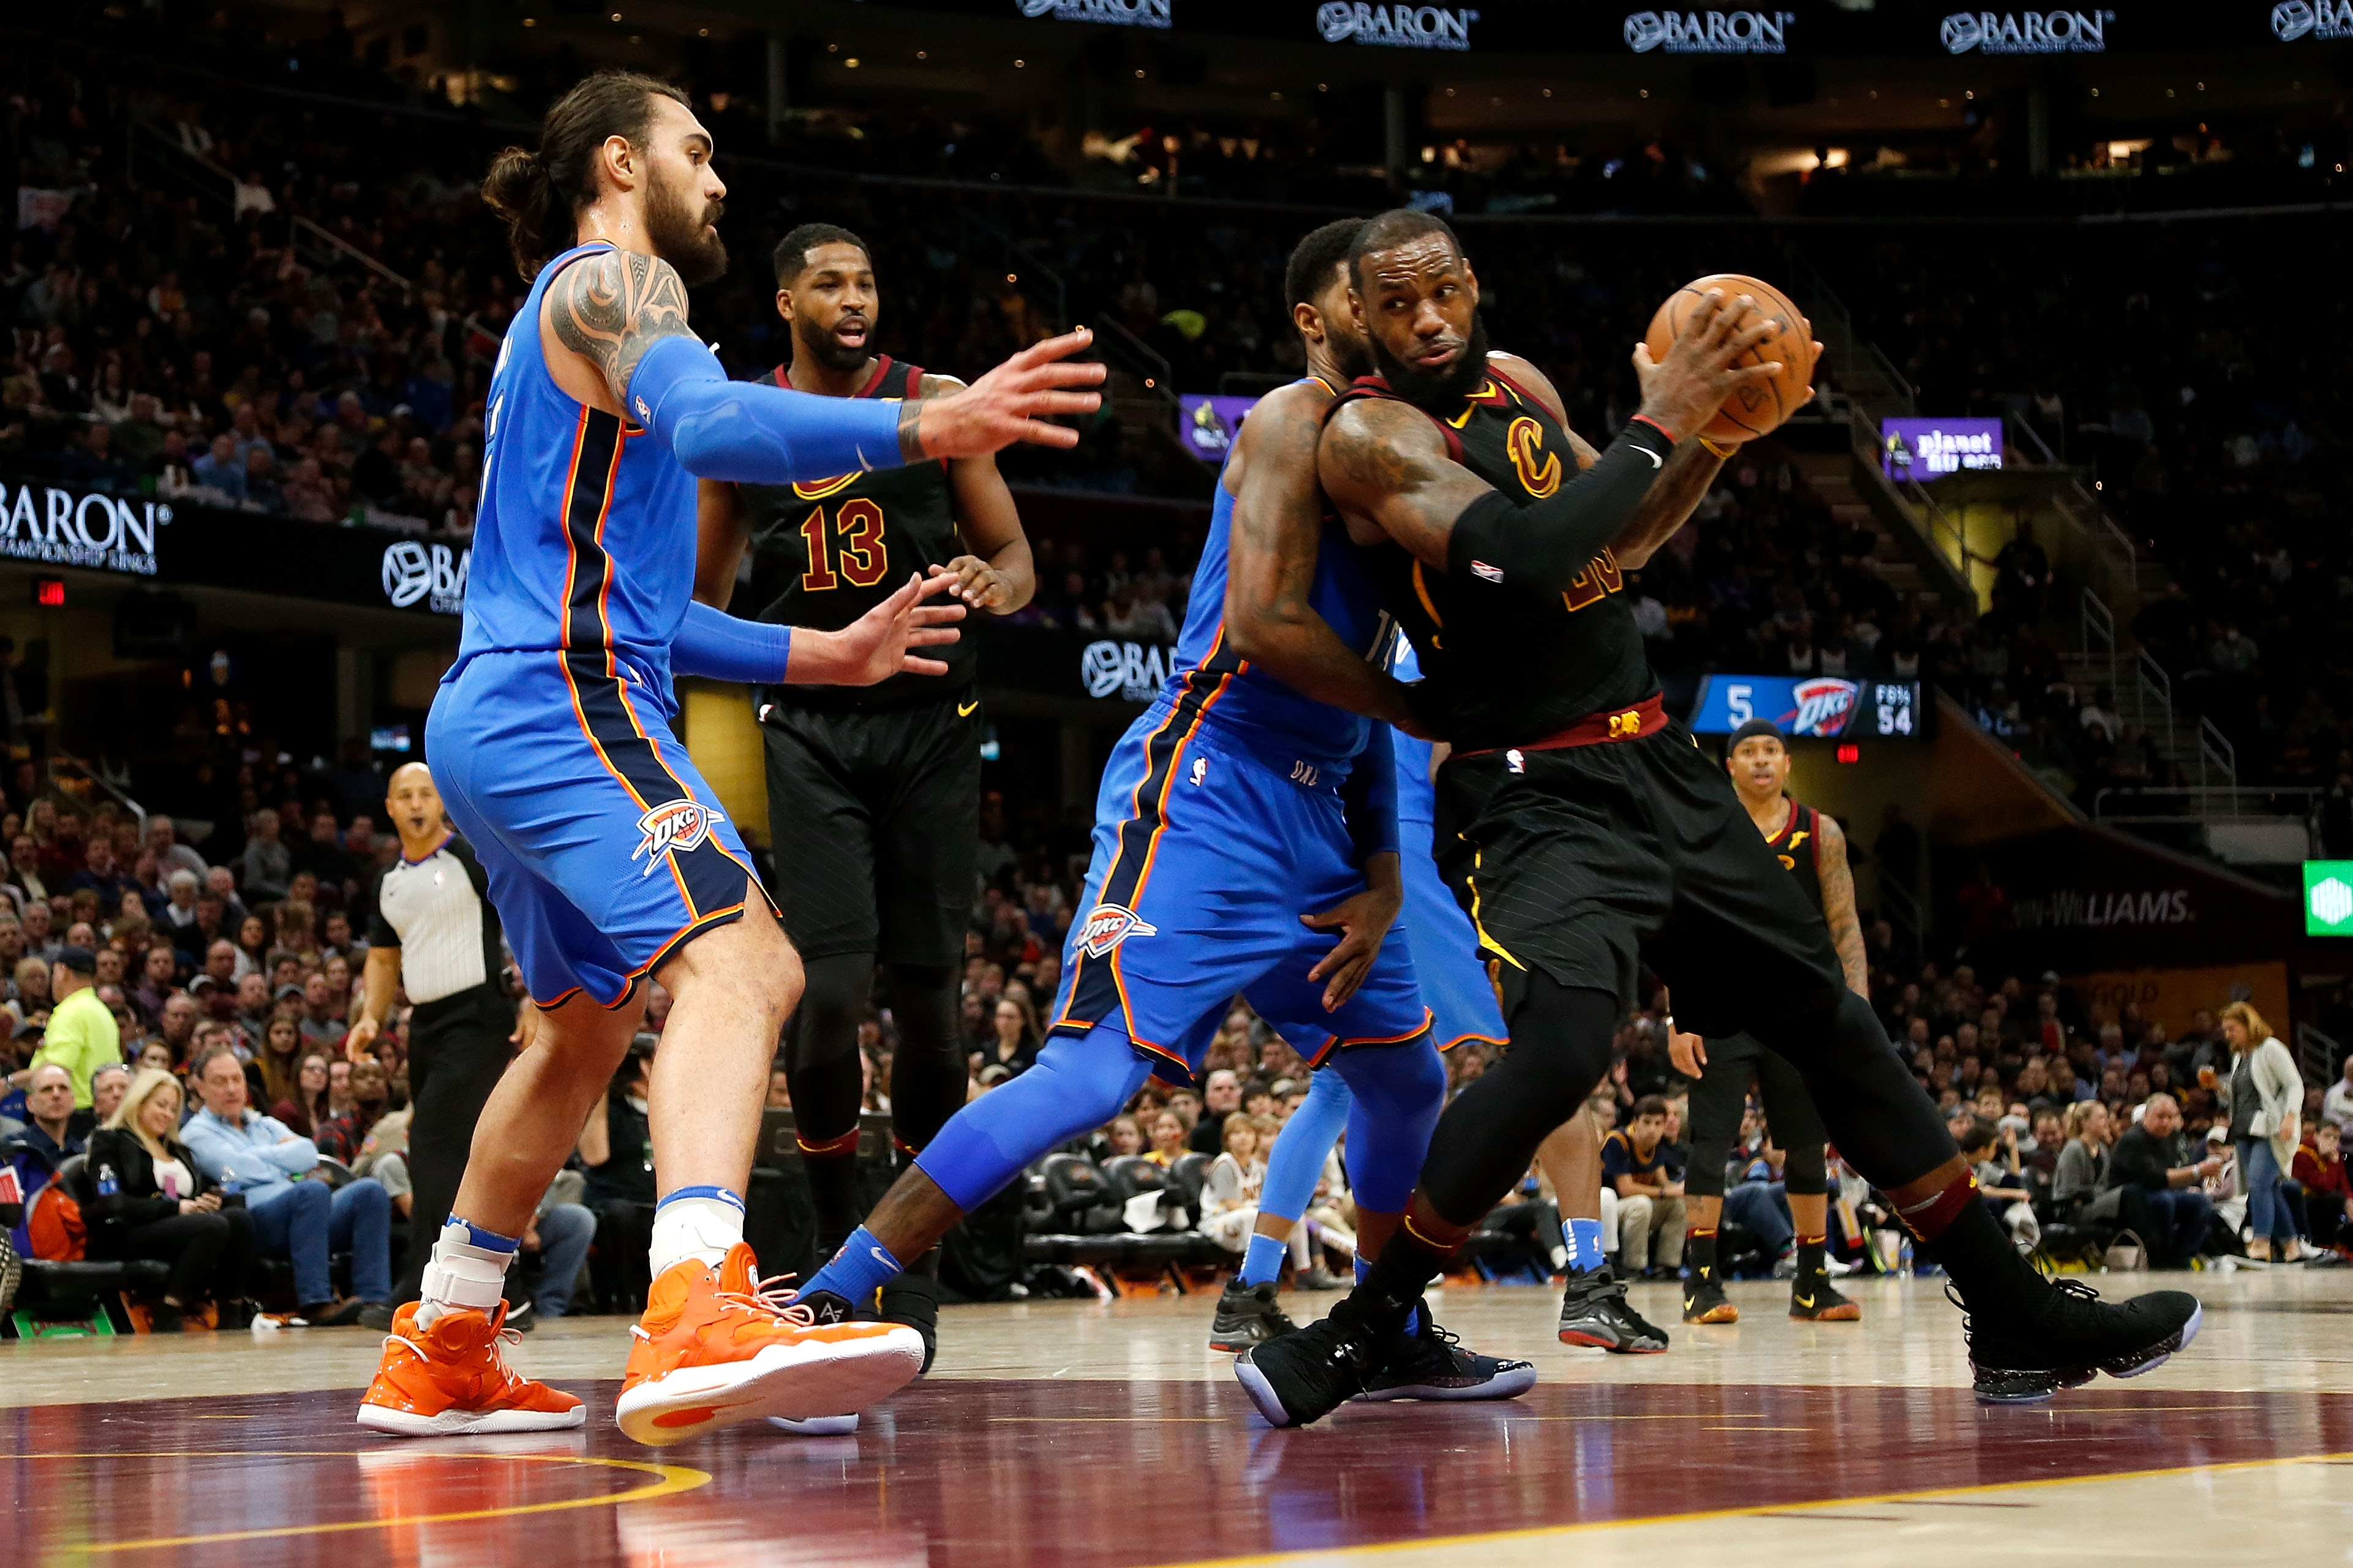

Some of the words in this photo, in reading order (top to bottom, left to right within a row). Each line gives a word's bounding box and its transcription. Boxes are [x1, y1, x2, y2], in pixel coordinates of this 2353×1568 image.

[1353, 2, 1469, 40] BARON
[1662, 10, 1783, 44] BARON
[1980, 10, 2102, 44] BARON
[800, 498, 888, 591] 13
[1727, 684, 1753, 730] 5
[1877, 705, 1913, 735] 54
[652, 808, 696, 852] OKC
